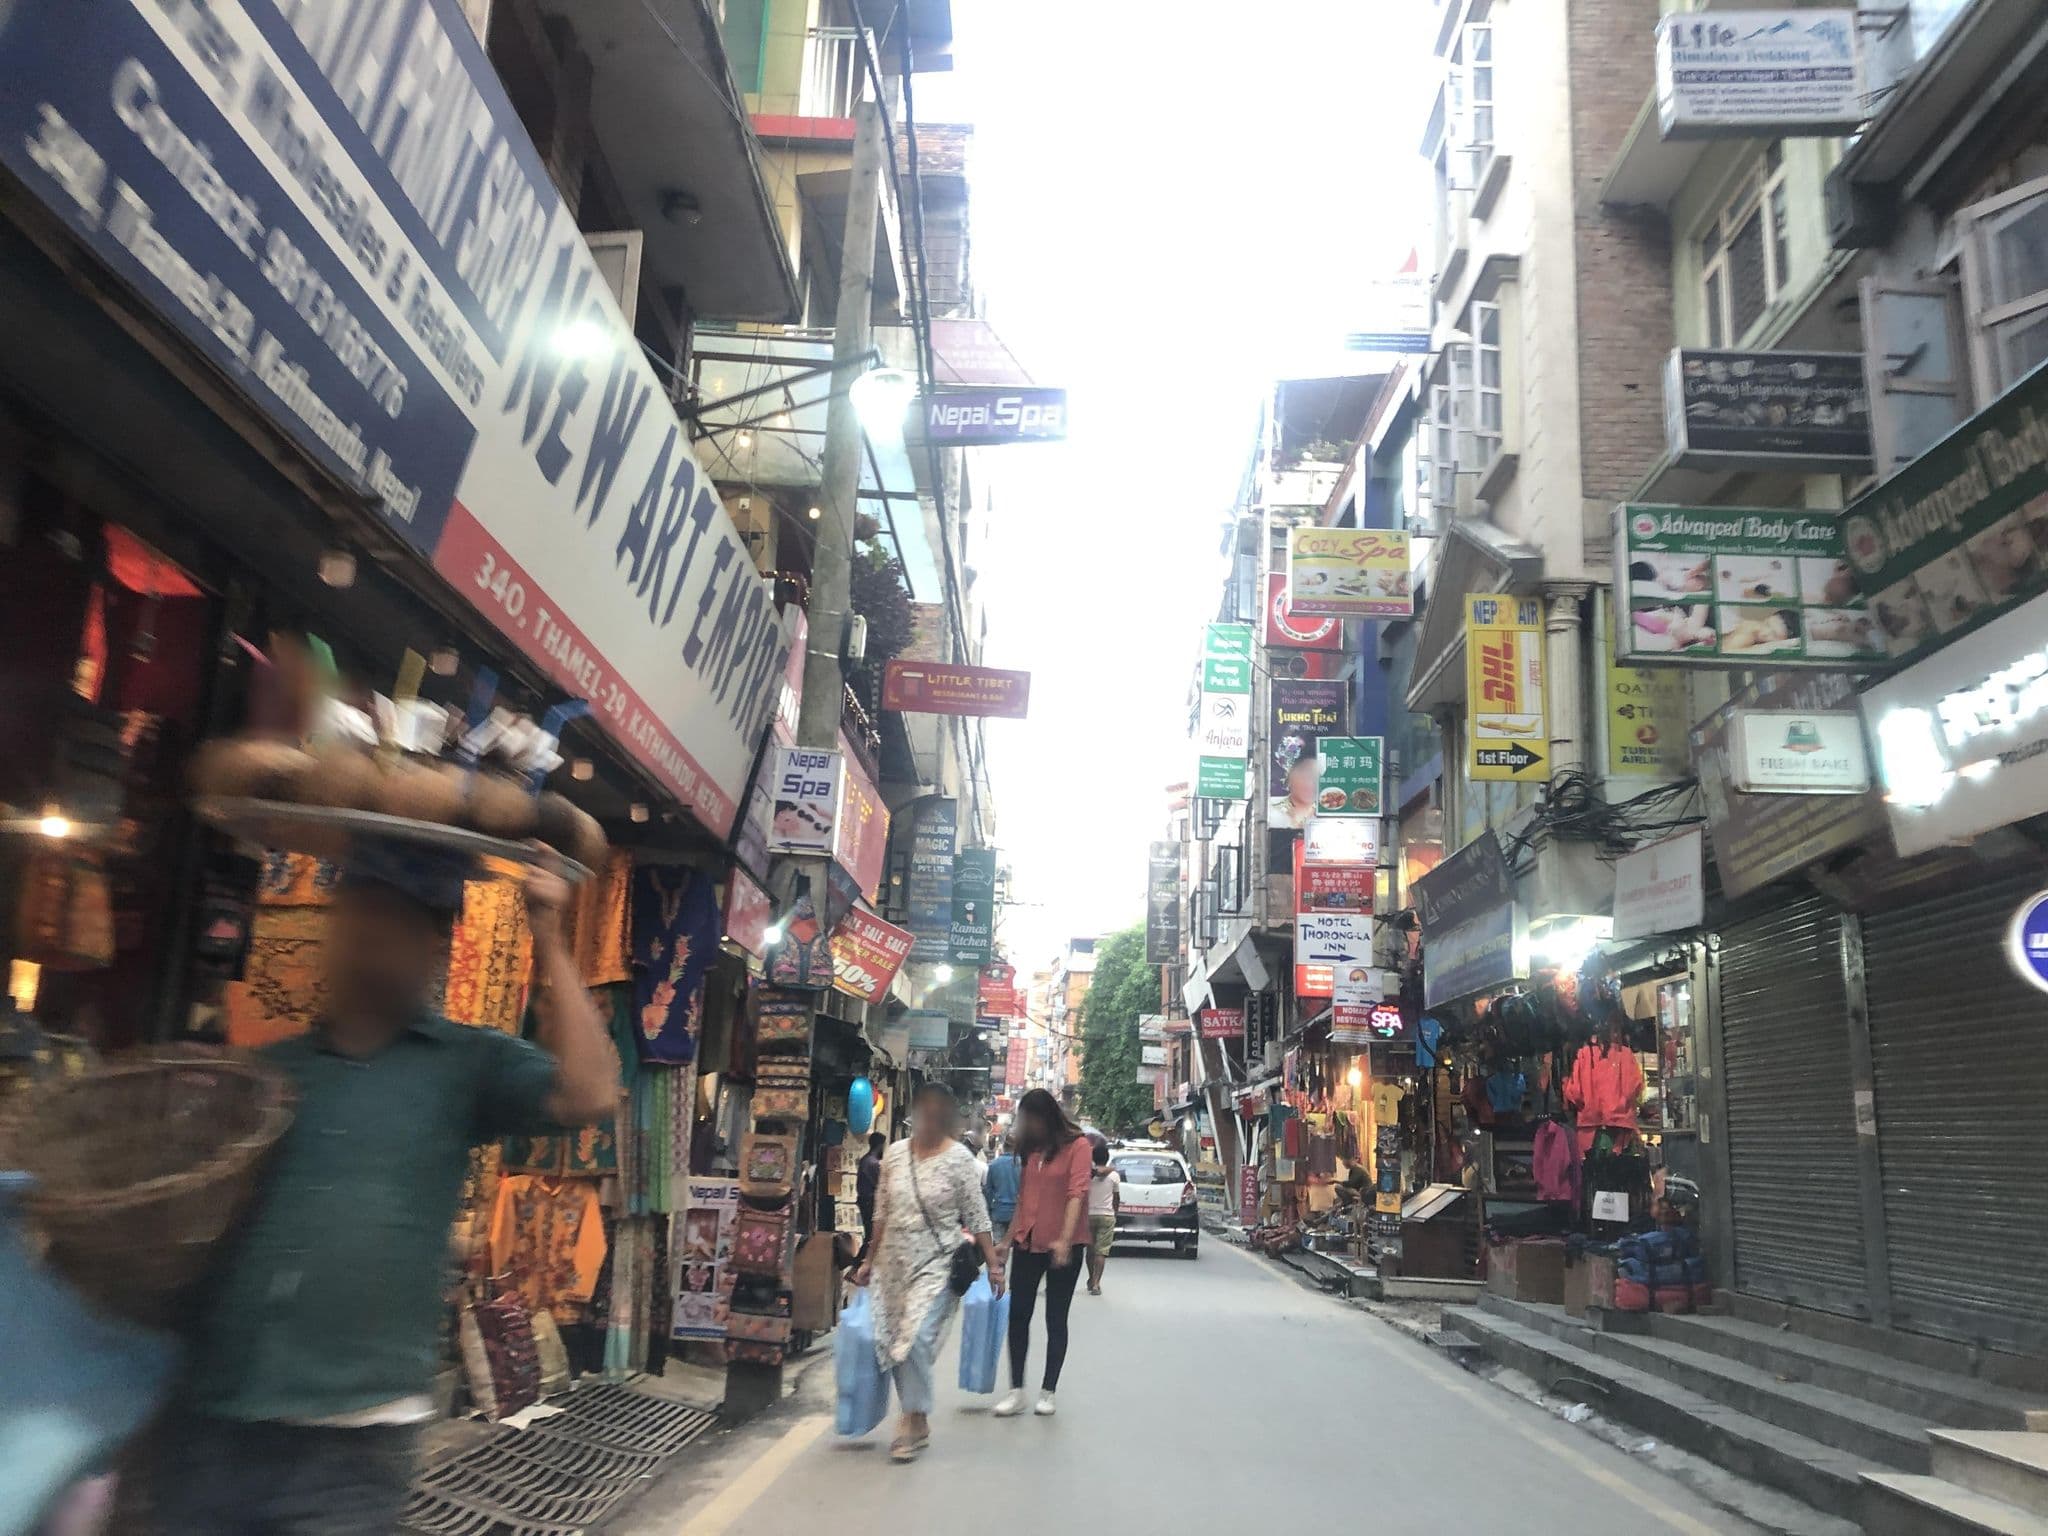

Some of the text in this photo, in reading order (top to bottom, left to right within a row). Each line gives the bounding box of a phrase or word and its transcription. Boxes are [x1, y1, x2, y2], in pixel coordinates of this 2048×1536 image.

[456, 135, 548, 335] SHOP
[993, 397, 1063, 434] Spa
[503, 240, 650, 531] NEW
[615, 423, 718, 630] ART
[1660, 512, 1836, 544] Advanced Body Care
[1340, 536, 1406, 565] Spa
[1517, 600, 1539, 625] AIR
[472, 551, 527, 629] 340,
[531, 607, 627, 728] THAMEL-29,
[928, 673, 1013, 689] LITTLE TIBET
[1482, 640, 1516, 703] DHL
[787, 752, 831, 772] Nepal
[1478, 751, 1529, 765] 1st Floor
[781, 774, 831, 799] Spa
[915, 837, 950, 850] MAGIC
[951, 921, 988, 934] Rama's
[1318, 917, 1352, 927] HOTEL
[861, 924, 885, 944] SALE
[884, 935, 908, 955] SALE
[950, 934, 988, 948] Kitchen
[1323, 943, 1346, 952] INN
[870, 954, 896, 971] SALE
[833, 957, 879, 992] 50%
[1371, 1010, 1403, 1030] SPA
[729, 1186, 741, 1200] S
